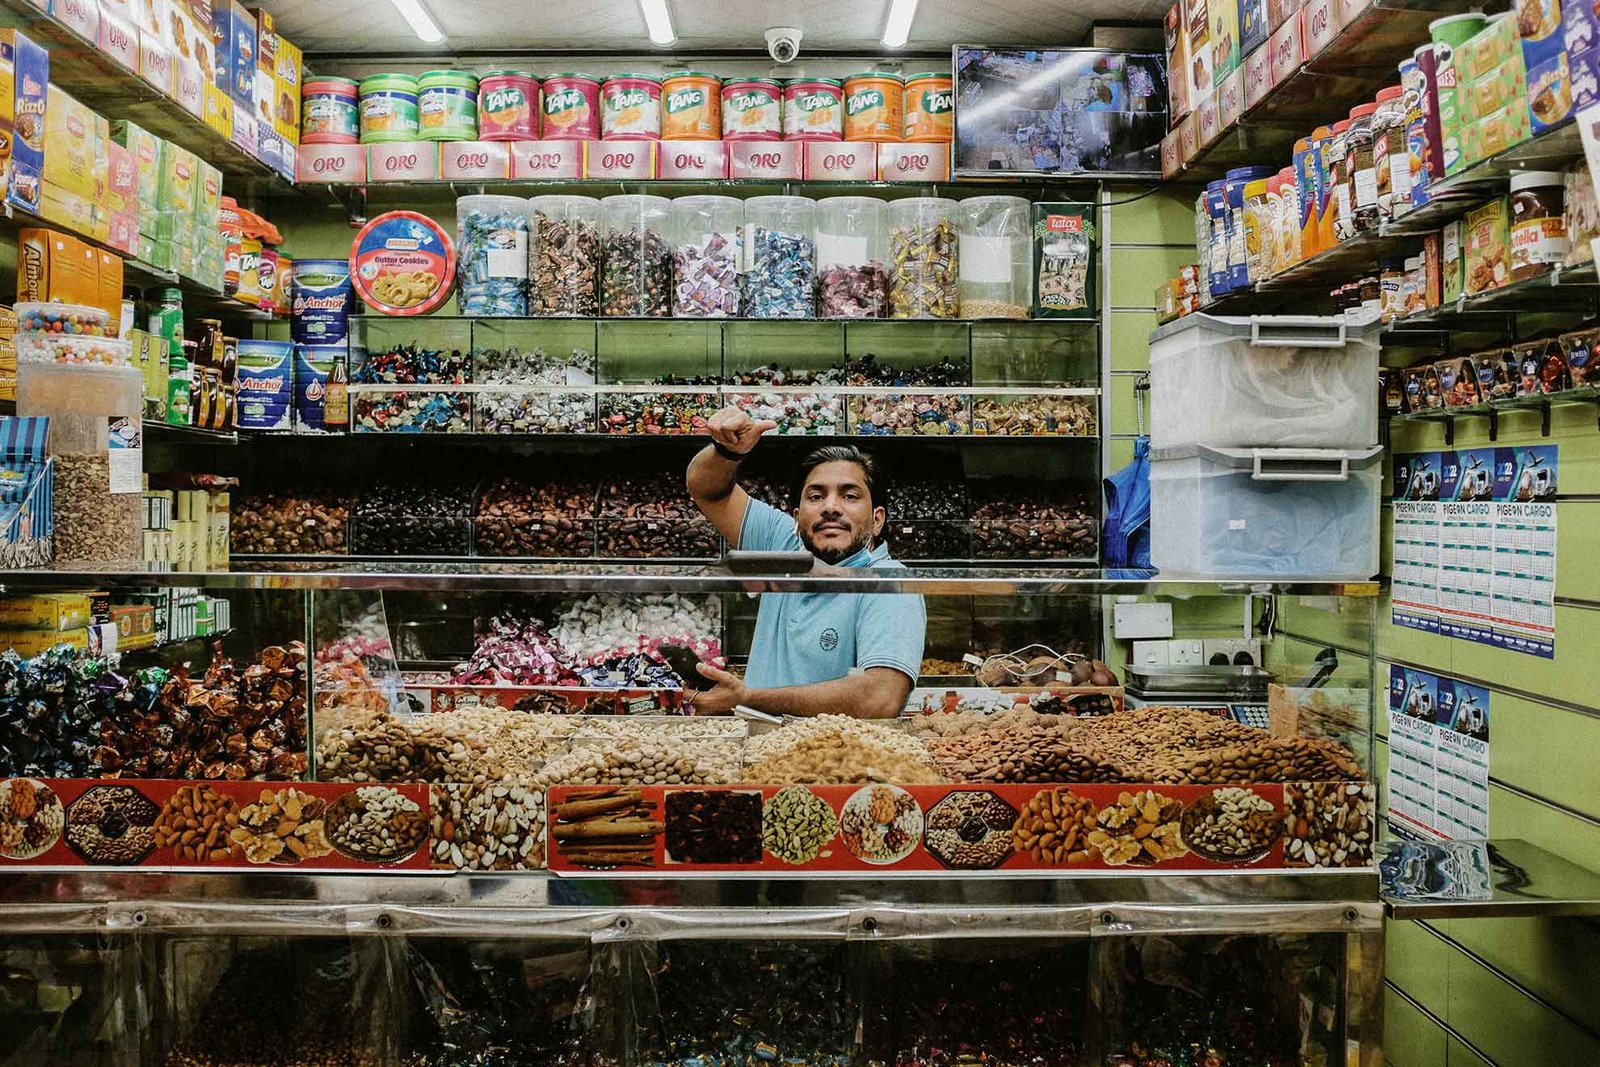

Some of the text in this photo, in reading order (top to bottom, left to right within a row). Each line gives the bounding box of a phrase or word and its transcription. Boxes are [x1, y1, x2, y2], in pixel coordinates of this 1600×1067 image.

[1312, 5, 1327, 36] ORO
[1279, 36, 1292, 64] ORO
[148, 52, 164, 74] ORO
[486, 92, 520, 112] TANG
[545, 92, 579, 114] TANG
[612, 92, 643, 110] TANG
[668, 92, 700, 113] TANG
[736, 94, 766, 110] TANG
[803, 94, 833, 110] TANG
[847, 92, 878, 114] TANG
[927, 93, 952, 112] TAN
[313, 156, 345, 172] ORO
[385, 154, 417, 171] ORO
[457, 153, 488, 170] ORO
[529, 153, 561, 169] ORO
[602, 153, 634, 169] ORO
[750, 153, 781, 168] ORO
[823, 154, 855, 170] ORO
[897, 154, 929, 171] ORO
[304, 296, 344, 309] Anchor
[243, 378, 282, 390] Anchor
[1395, 502, 1436, 513] PIGEON CARGO
[1443, 504, 1489, 514] PIGEON CARGO
[1497, 504, 1552, 517] PIGEON CARGO
[1392, 713, 1433, 735] PIGEON CARGO
[1440, 728, 1485, 754] PIGEON CARGO
